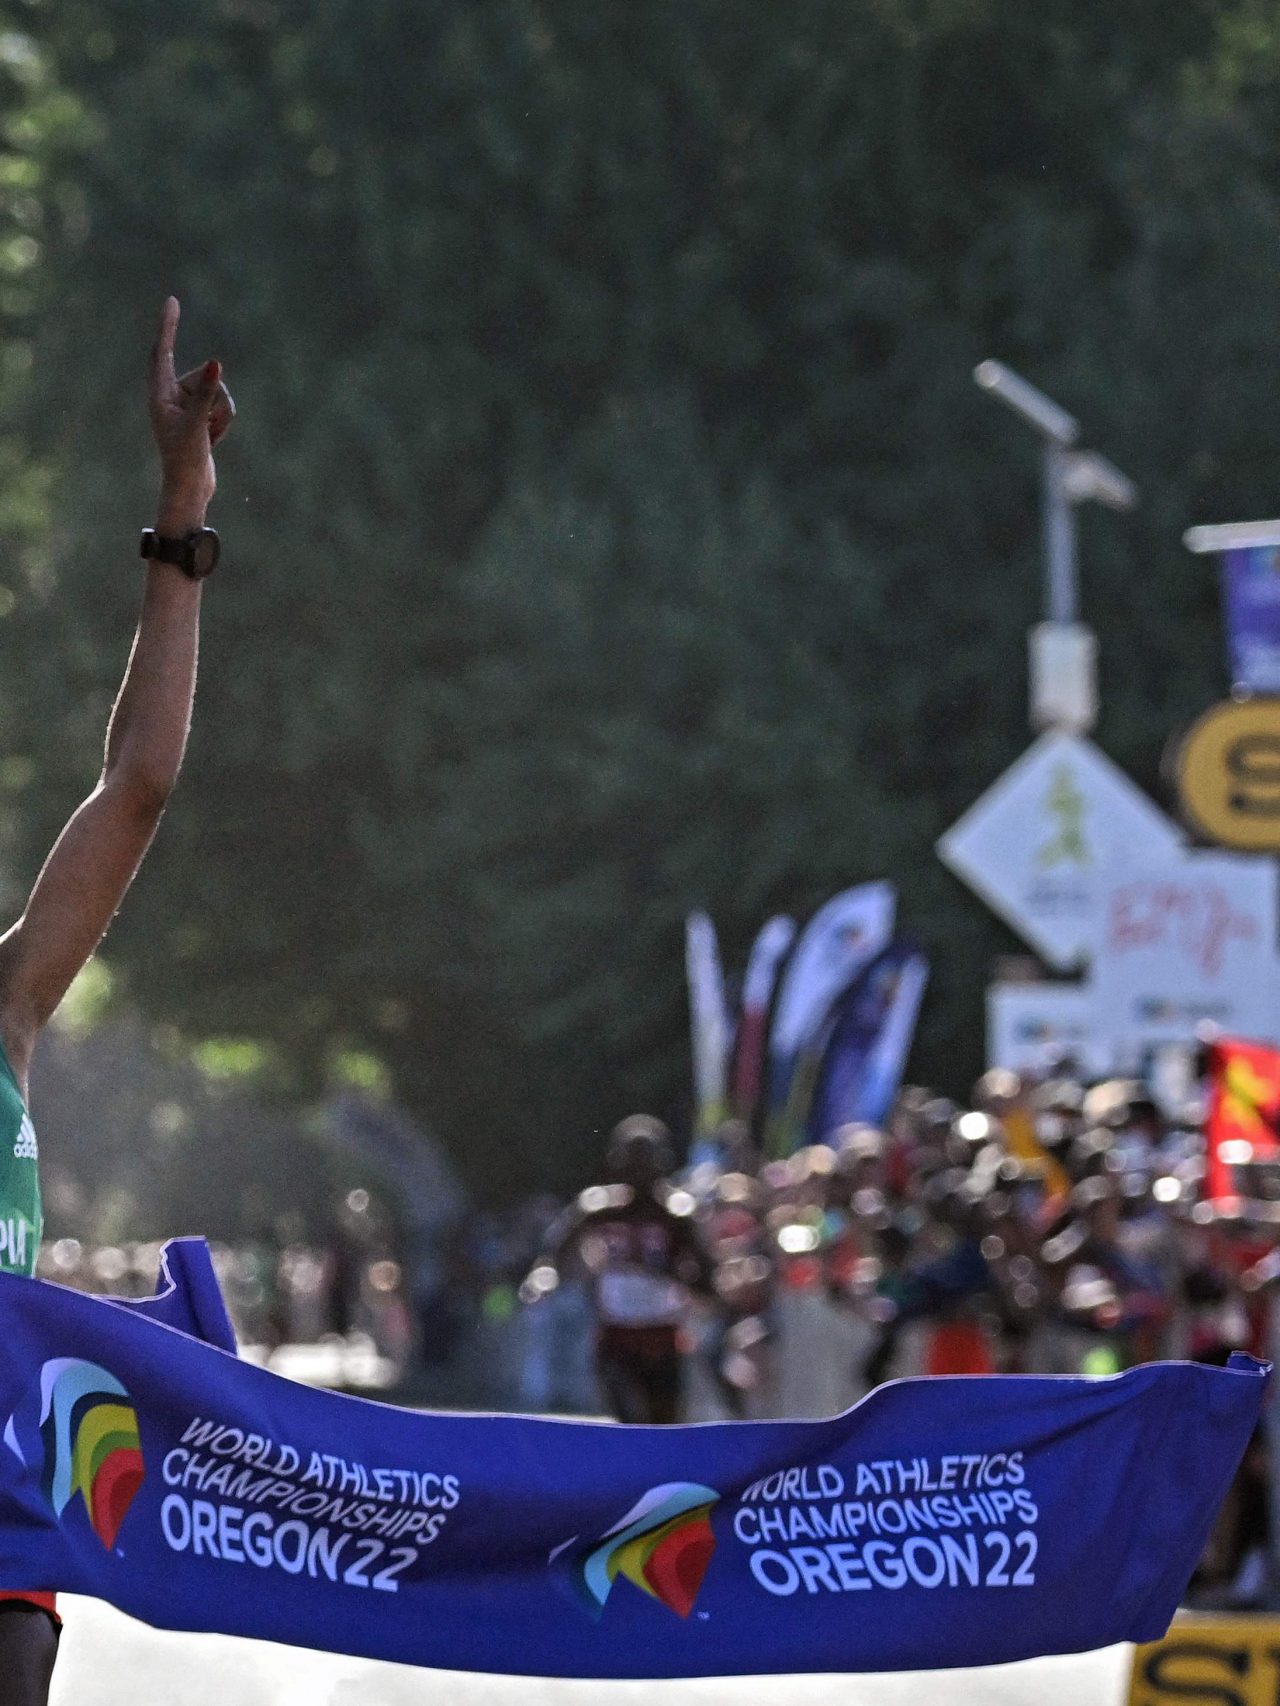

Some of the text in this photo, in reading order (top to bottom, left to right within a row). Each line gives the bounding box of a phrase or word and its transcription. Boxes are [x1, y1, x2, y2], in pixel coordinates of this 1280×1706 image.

[162, 1448, 448, 1546] CHAMPIONSHIPS
[180, 1417, 461, 1511] WORLD ATHLETICS
[741, 1451, 1026, 1503] WORLD ATHLETICS
[733, 1488, 1040, 1545] CHAMPIONSHIPS
